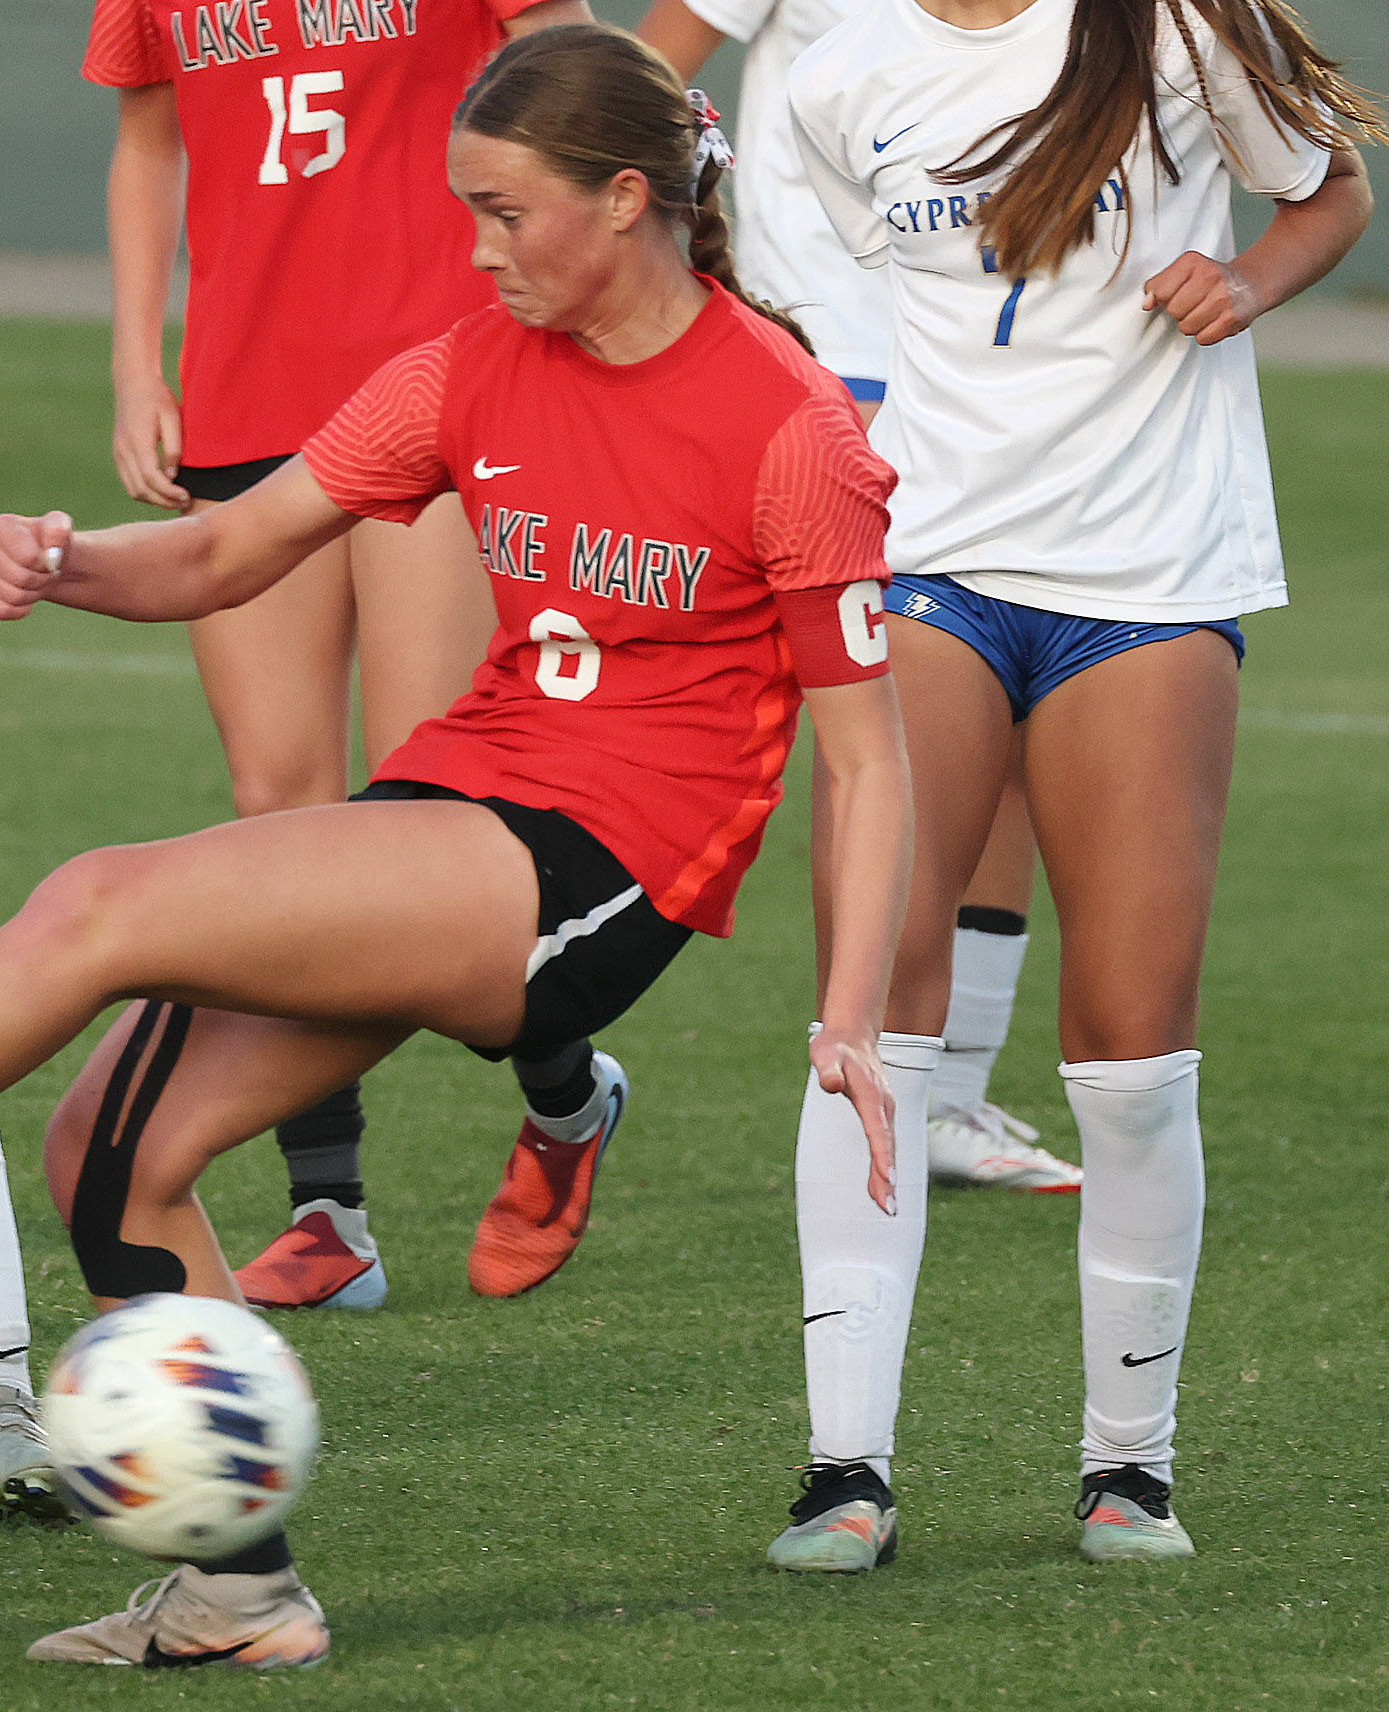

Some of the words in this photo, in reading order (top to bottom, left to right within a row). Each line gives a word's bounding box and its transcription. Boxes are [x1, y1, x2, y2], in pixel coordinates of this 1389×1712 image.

[171, 0, 280, 72] LAKE
[296, 0, 418, 49] MARY
[258, 70, 347, 185] 15
[887, 191, 994, 233] CYPR
[1092, 178, 1128, 213] AY
[477, 503, 550, 582] AKE
[569, 523, 711, 612] MARY
[837, 579, 890, 667] C
